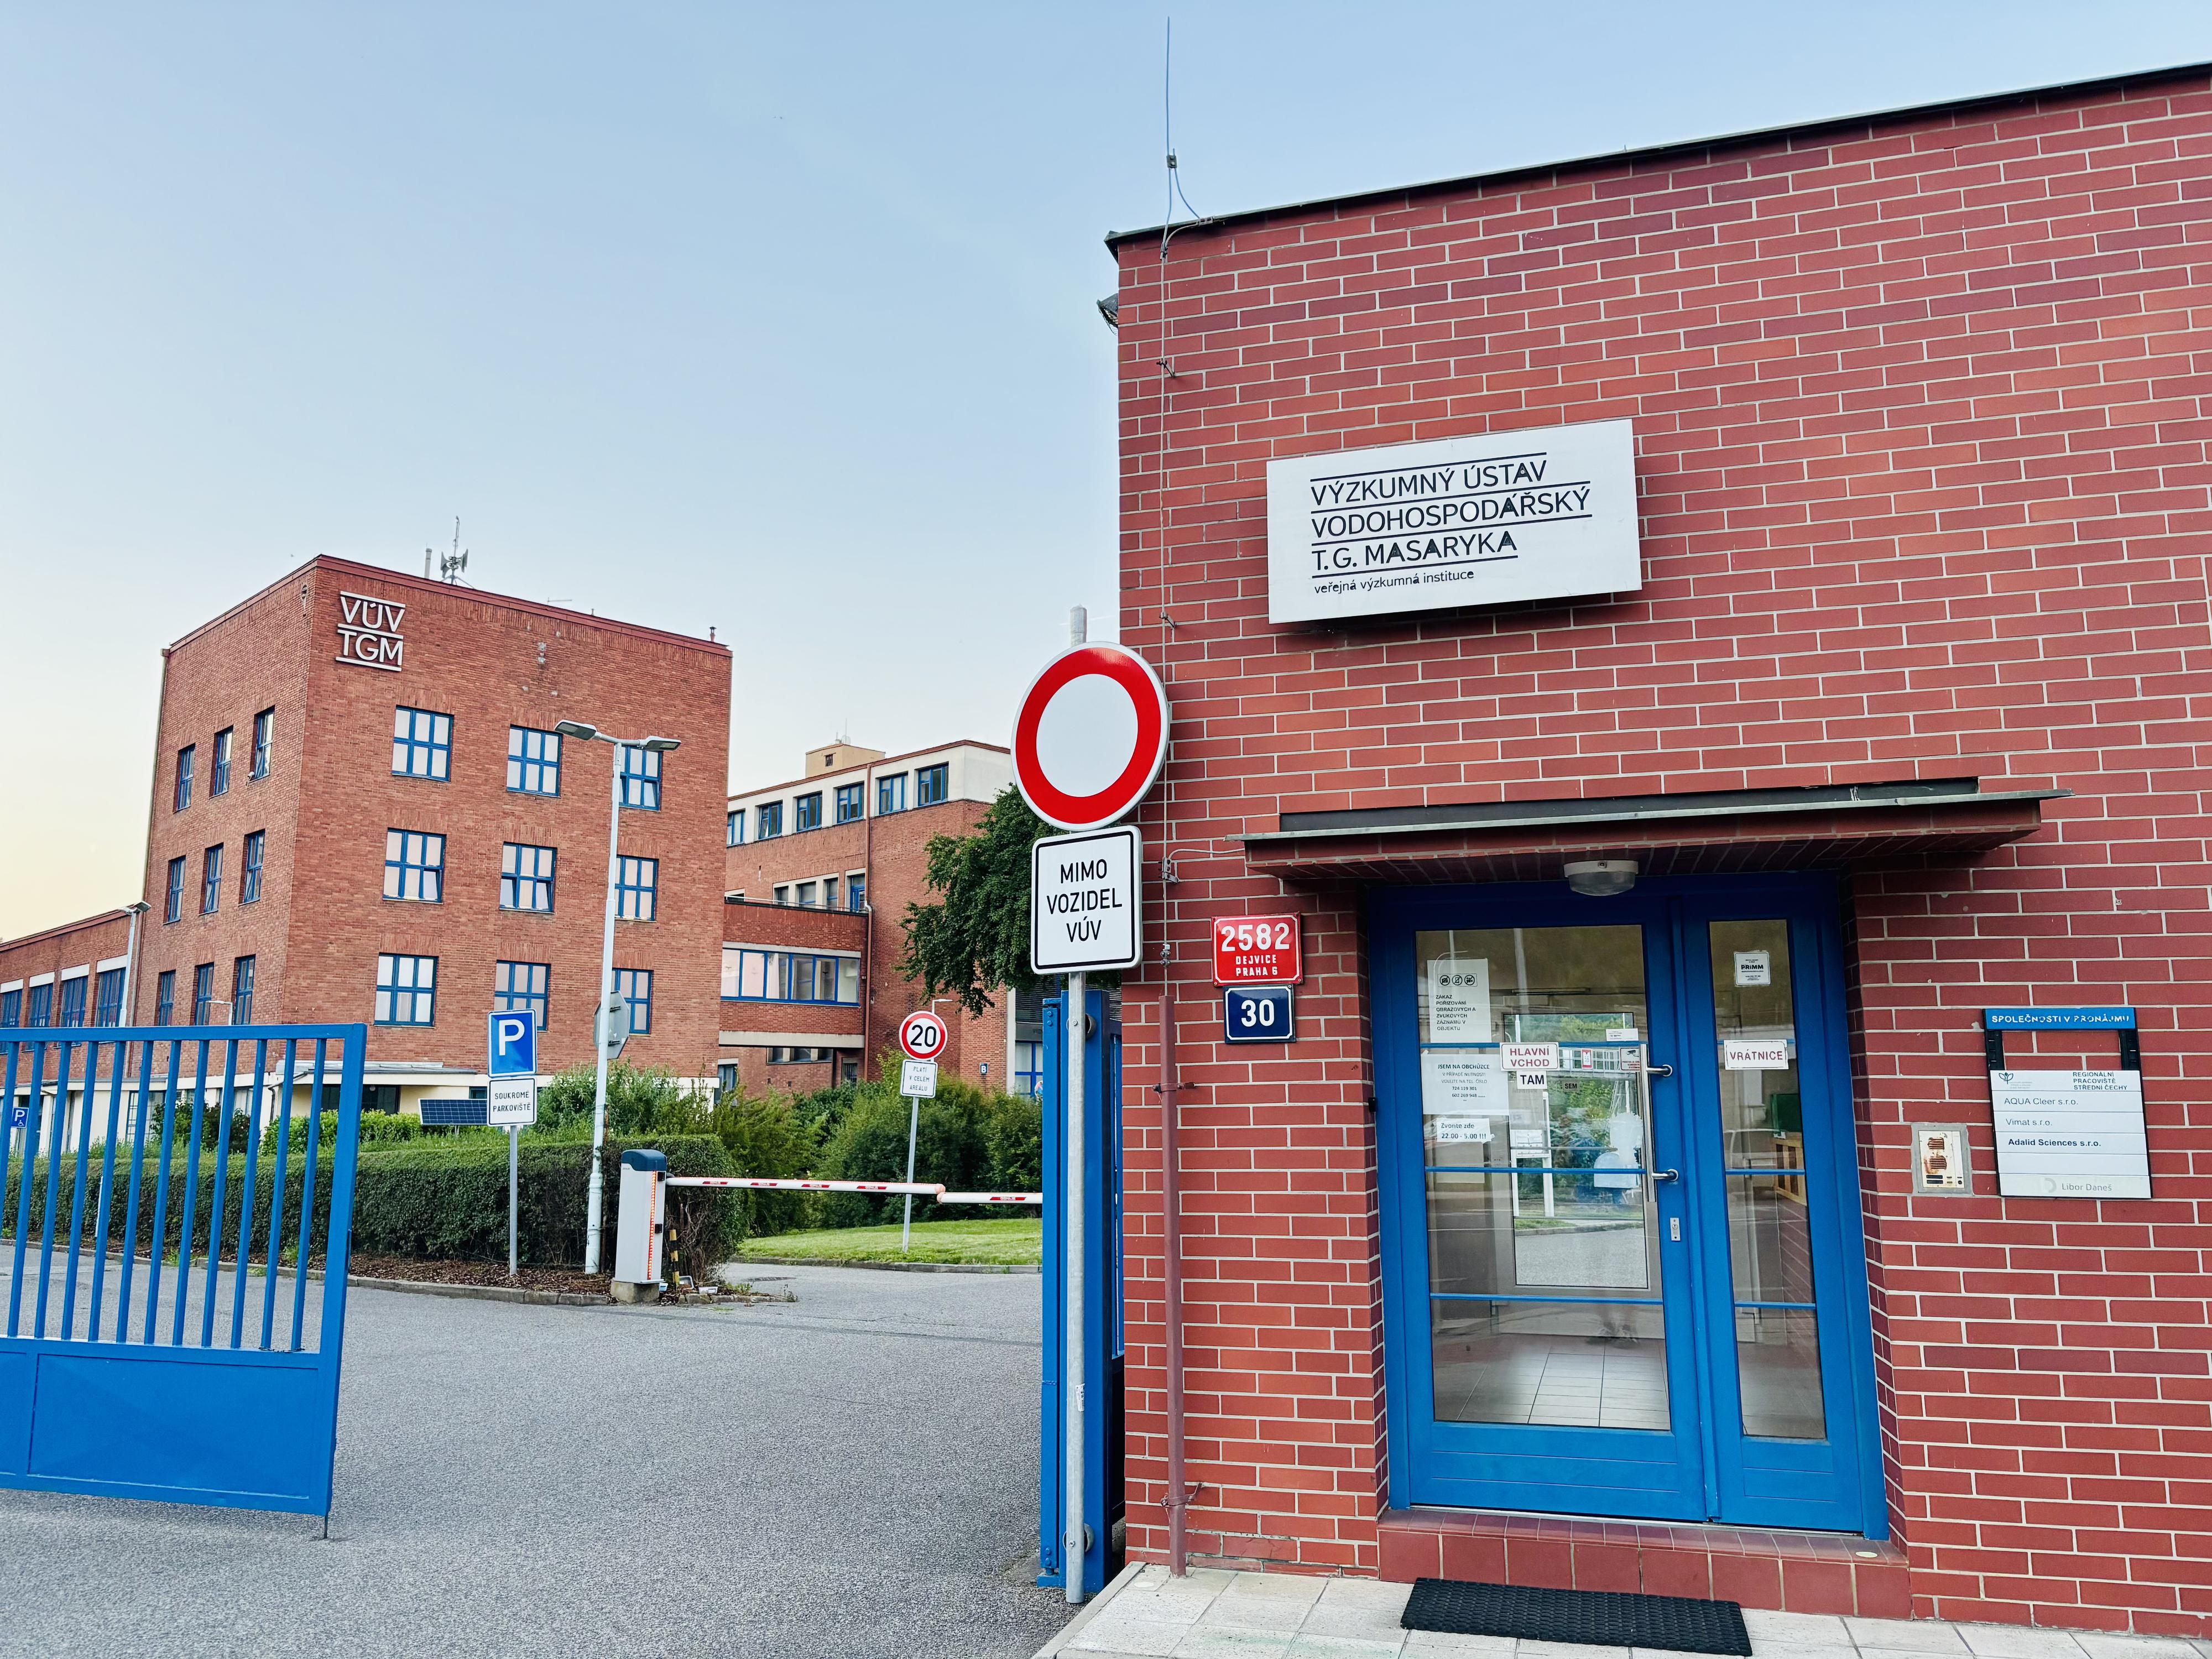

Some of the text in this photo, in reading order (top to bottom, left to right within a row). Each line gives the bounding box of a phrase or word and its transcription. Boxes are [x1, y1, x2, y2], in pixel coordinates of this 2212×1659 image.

[1311, 460, 1547, 506] VÝZKUMNÝ ÚSTAV
[1311, 485, 1591, 538] VODOHOSPODÁŘSKÝ
[1365, 530, 1517, 566] MASARYKA
[1314, 569, 1474, 594] veřejná výzkumná instituce
[340, 596, 405, 633] VÚV
[337, 629, 404, 666] TGM
[1060, 858, 1108, 884] MIMO
[1046, 888, 1123, 915] VOZIDEL
[1066, 916, 1102, 943] VÚV
[1220, 922, 1291, 952] 2582
[1235, 954, 1277, 965] DEJVICE
[1235, 966, 1279, 977] PRAHA 6
[1240, 999, 1275, 1027] 30
[1991, 1013, 2062, 1023] SPOLEČNOSTI
[498, 1019, 525, 1056] P
[910, 1024, 937, 1048] 20
[1509, 1045, 1550, 1056] HLAVNÍ
[1729, 1048, 1783, 1061] VRÁTNICE
[980, 1065, 987, 1073] B
[1510, 1058, 1550, 1067] VCHOD
[1520, 1074, 1545, 1086] TAM
[494, 1091, 530, 1100] SOUKROMÉ
[2004, 1097, 2031, 1105] AQUA
[493, 1103, 531, 1112] PARKOVIŠTĚ
[14, 1109, 25, 1121] P
[2005, 1118, 2030, 1126] Vimat
[2062, 1183, 2112, 1192] Libor Daneš
